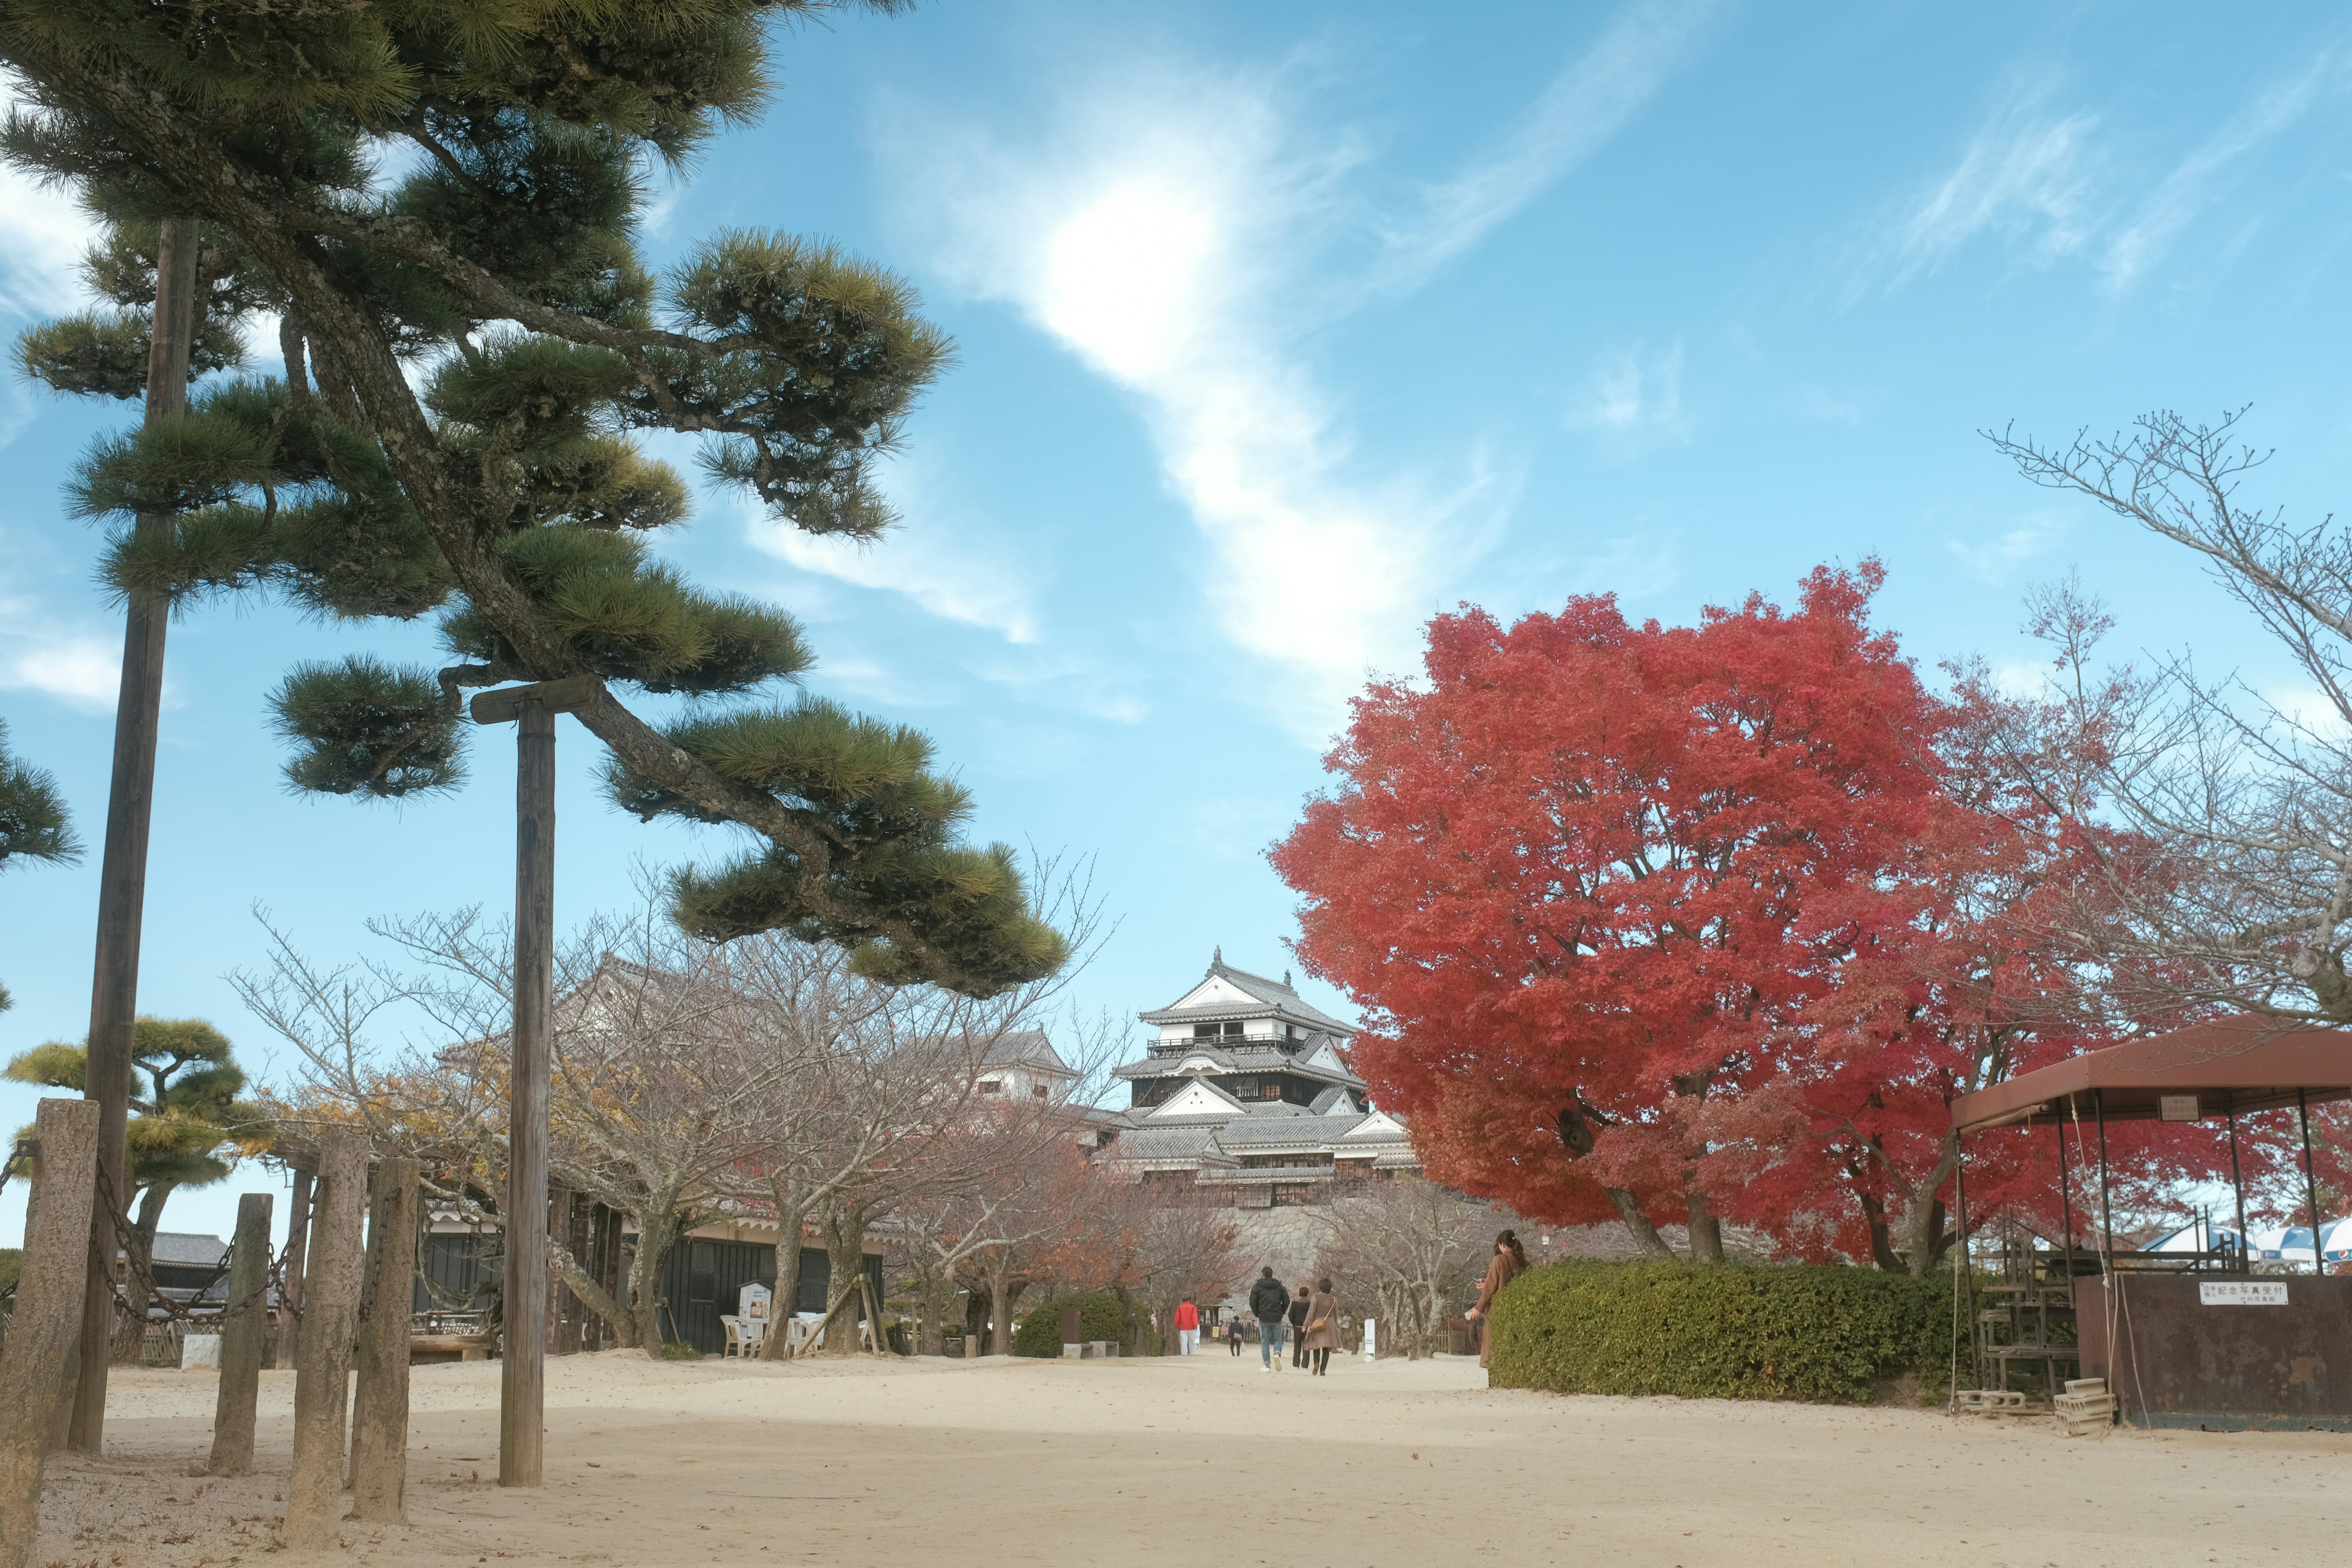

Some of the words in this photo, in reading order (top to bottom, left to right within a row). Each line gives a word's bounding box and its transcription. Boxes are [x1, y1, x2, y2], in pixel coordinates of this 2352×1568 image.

[2218, 1286, 2282, 1295] 記念写真受付
